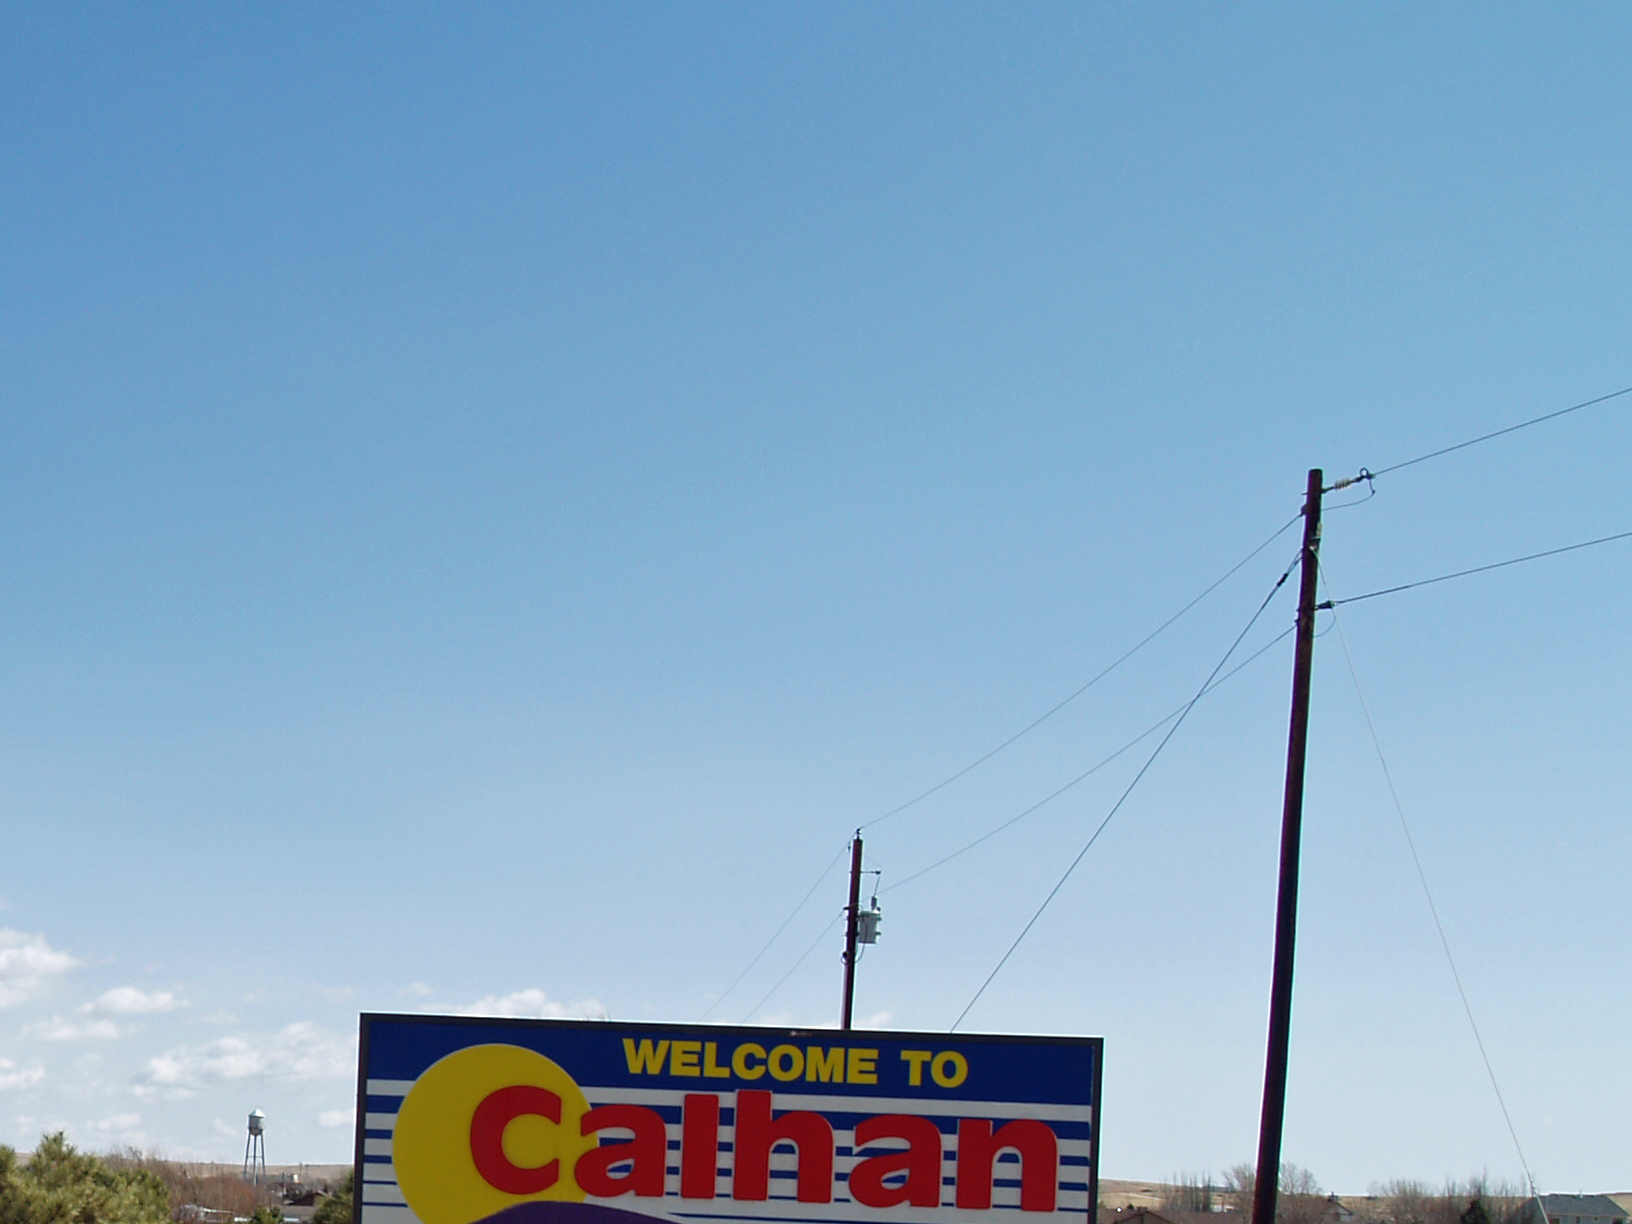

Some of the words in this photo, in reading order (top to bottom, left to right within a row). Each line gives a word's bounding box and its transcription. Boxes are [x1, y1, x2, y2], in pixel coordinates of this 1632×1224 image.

[622, 1037, 879, 1084] WELCOME
[900, 1049, 968, 1088] TO
[470, 1084, 1058, 1212] Calhan
